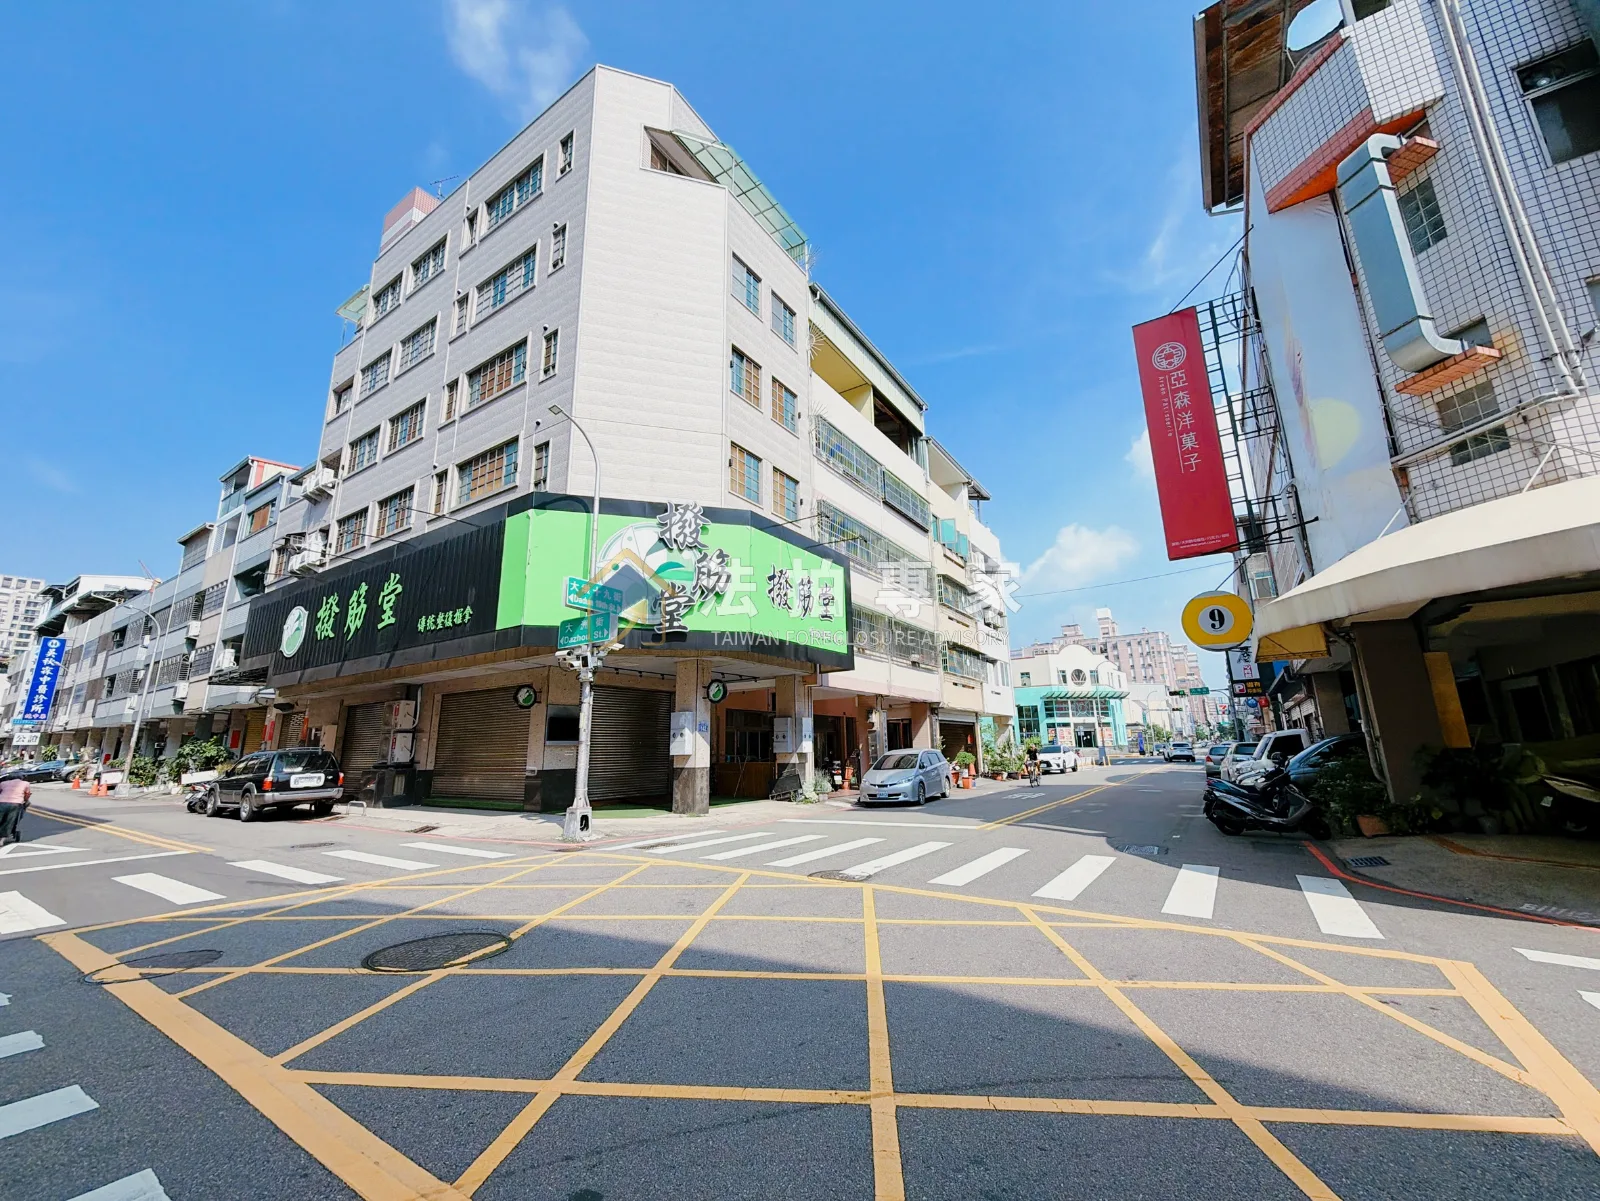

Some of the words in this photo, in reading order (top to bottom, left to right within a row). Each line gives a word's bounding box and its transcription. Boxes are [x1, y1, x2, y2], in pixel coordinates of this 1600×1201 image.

[1170, 370, 1202, 472] 亞森洋菓子
[654, 501, 732, 634] 撥筋堂
[766, 564, 836, 622] 撥筋堂
[315, 572, 403, 642] 撥筋堂
[1208, 608, 1225, 630] 9
